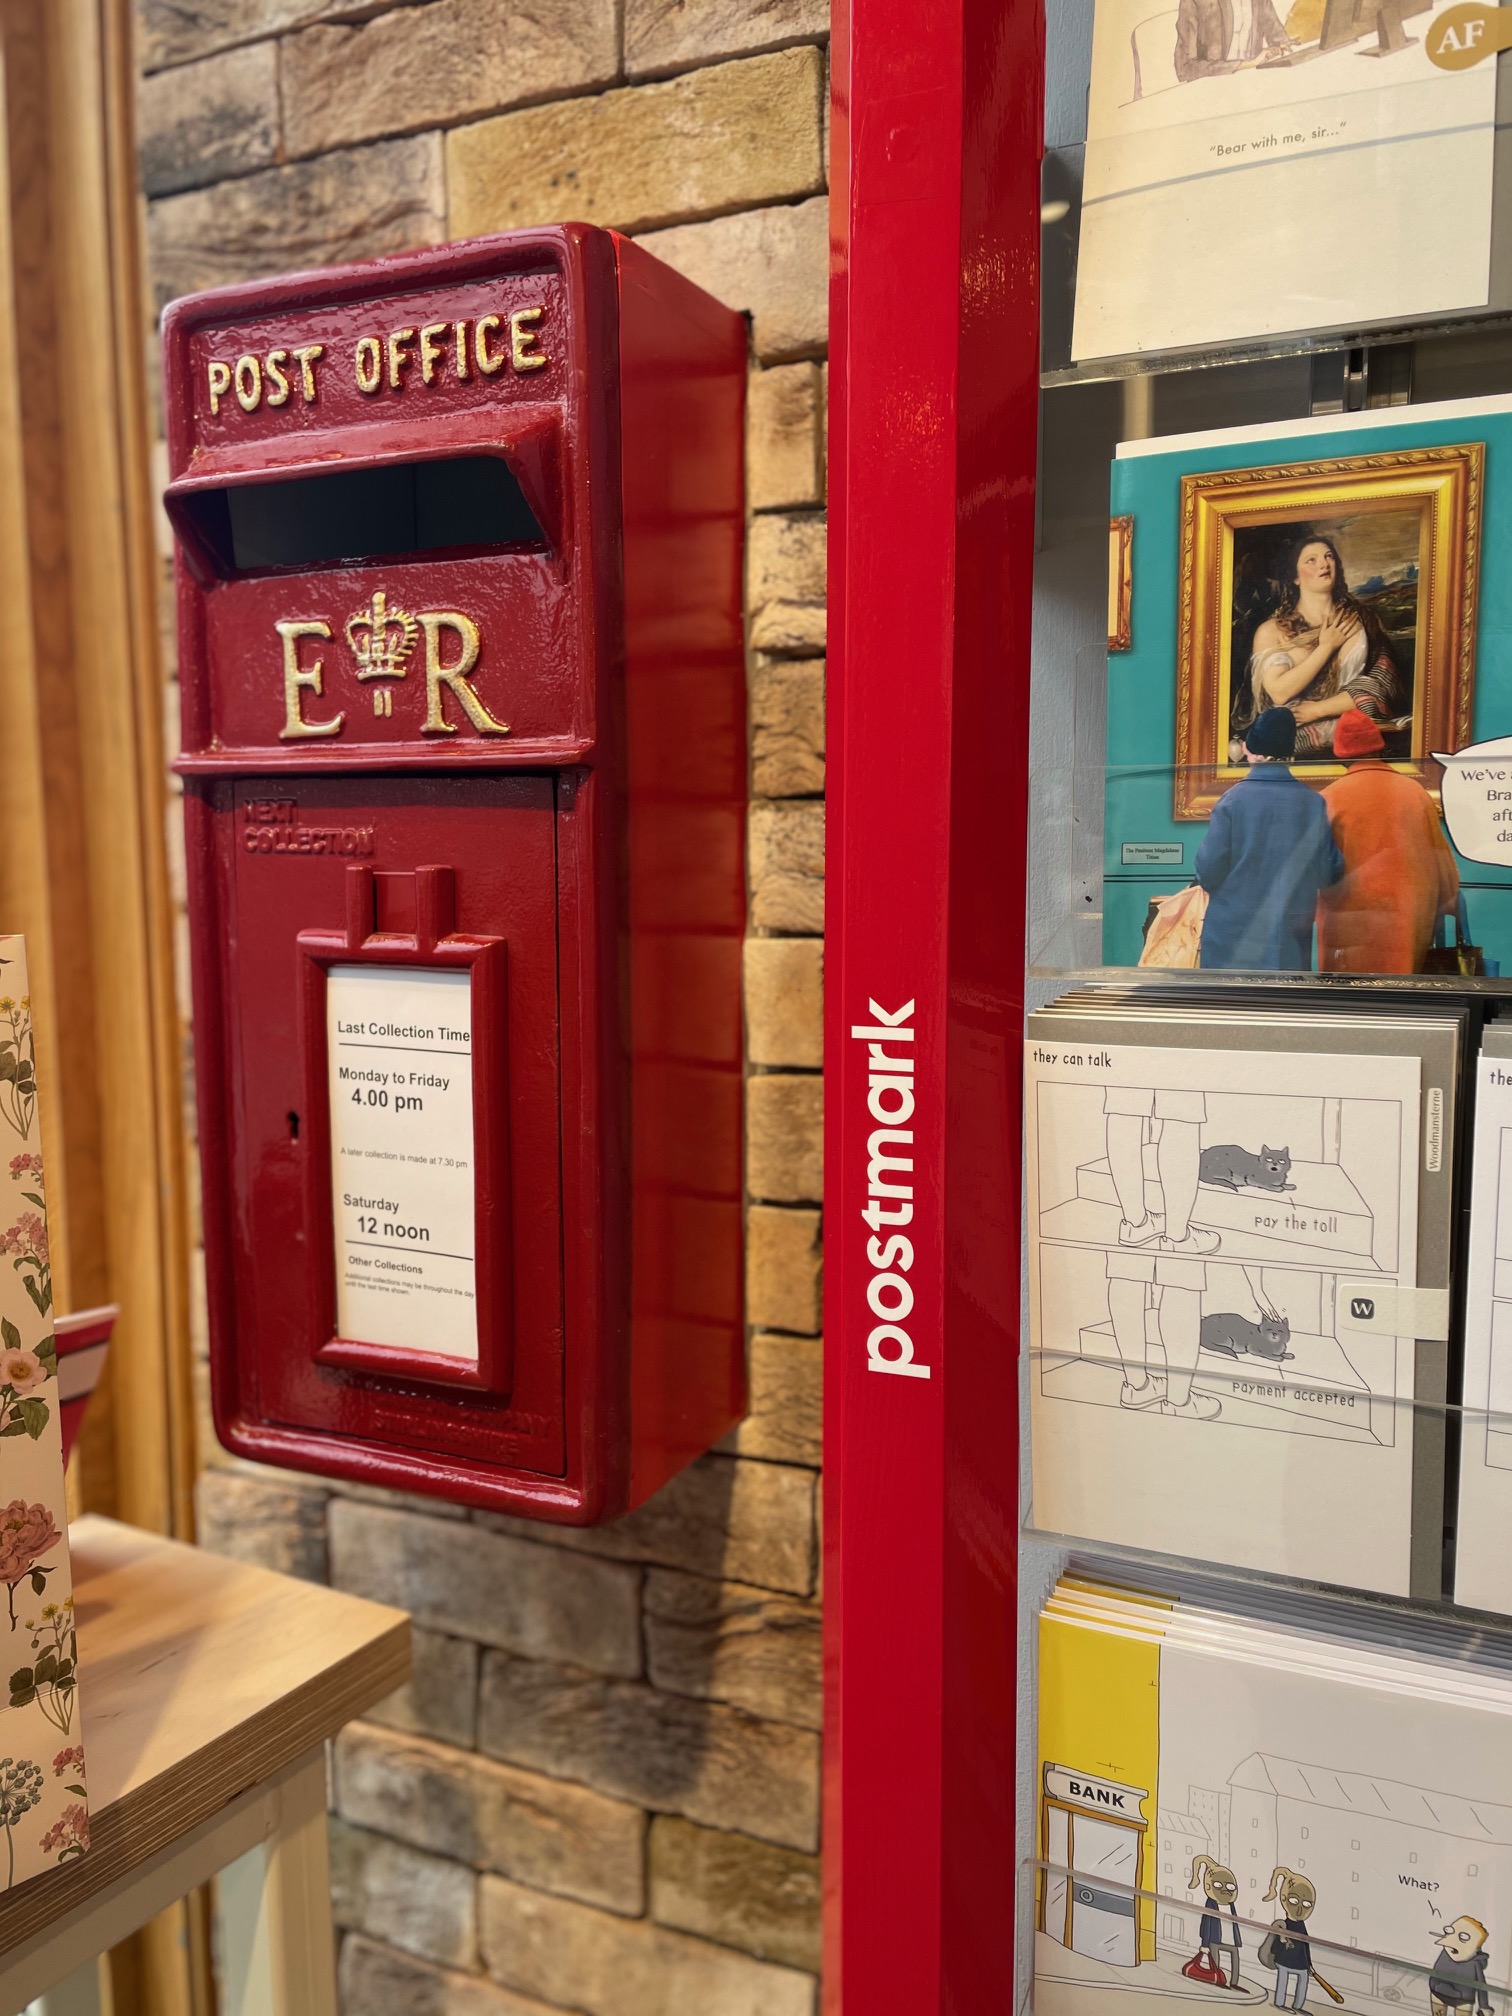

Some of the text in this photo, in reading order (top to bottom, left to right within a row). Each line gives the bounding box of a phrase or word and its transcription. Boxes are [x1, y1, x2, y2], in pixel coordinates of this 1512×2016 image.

[1436, 19, 1485, 54] AF
[1251, 134, 1277, 150] with
[1282, 133, 1306, 143] me,
[208, 305, 547, 415] POST OFFICE
[1460, 769, 1507, 781] We've
[244, 826, 375, 856] COLLECTION
[338, 1020, 471, 1042] Last Collection Time
[1033, 1047, 1112, 1068] they can talk
[339, 1066, 450, 1091] Monday to Friday
[351, 1088, 423, 1113] 4.00 pm
[1428, 1089, 1441, 1170] Woodmansterne
[340, 1147, 468, 1169] A later collection is made at 7.30 pm
[851, 997, 931, 1379] postmark
[343, 1193, 399, 1214] Saturday
[357, 1215, 430, 1241] 12 noon
[1254, 1213, 1338, 1233] pay the toll
[348, 1255, 423, 1275] Other Collections
[372, 1276, 401, 1286] collections
[423, 1283, 453, 1294] throughout
[454, 1288, 463, 1296] the
[1232, 1381, 1355, 1407] payment accepted
[1069, 1781, 1125, 1809] BANK
[1398, 1874, 1440, 1892] What?
